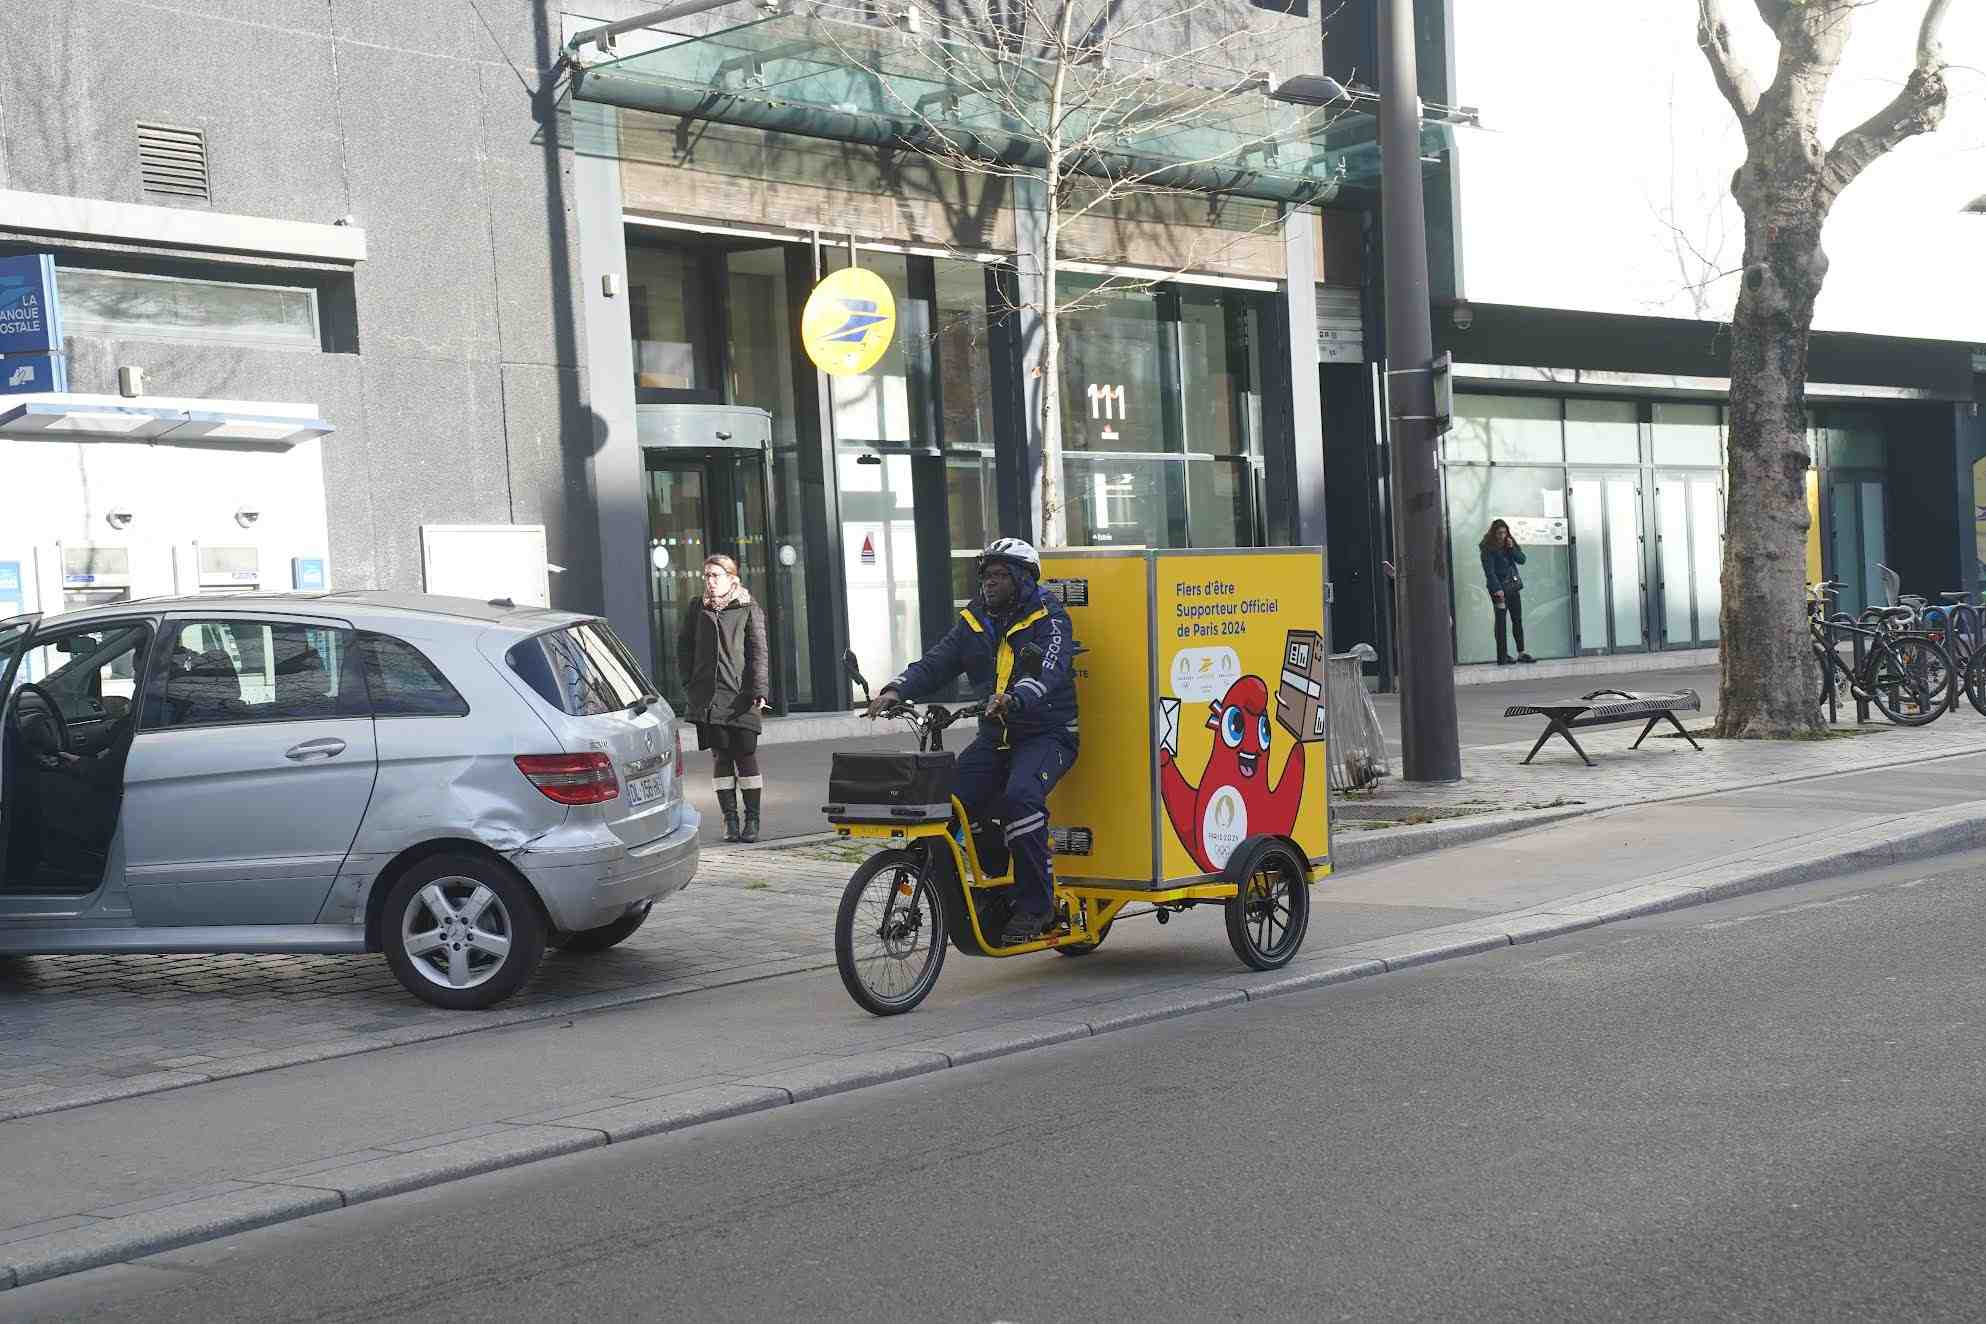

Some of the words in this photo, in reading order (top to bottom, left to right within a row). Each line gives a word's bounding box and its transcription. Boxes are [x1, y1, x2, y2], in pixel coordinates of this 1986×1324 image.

[23, 295, 38, 306] LA
[1088, 384, 1125, 419] 111
[1176, 583, 1202, 596] Fiers
[1204, 581, 1235, 595] d'être
[1176, 603, 1238, 619] Supporteur
[1240, 599, 1278, 614] Officiel
[1176, 623, 1190, 637] de
[1193, 623, 1218, 637] Paris
[1221, 622, 1246, 635] 2024
